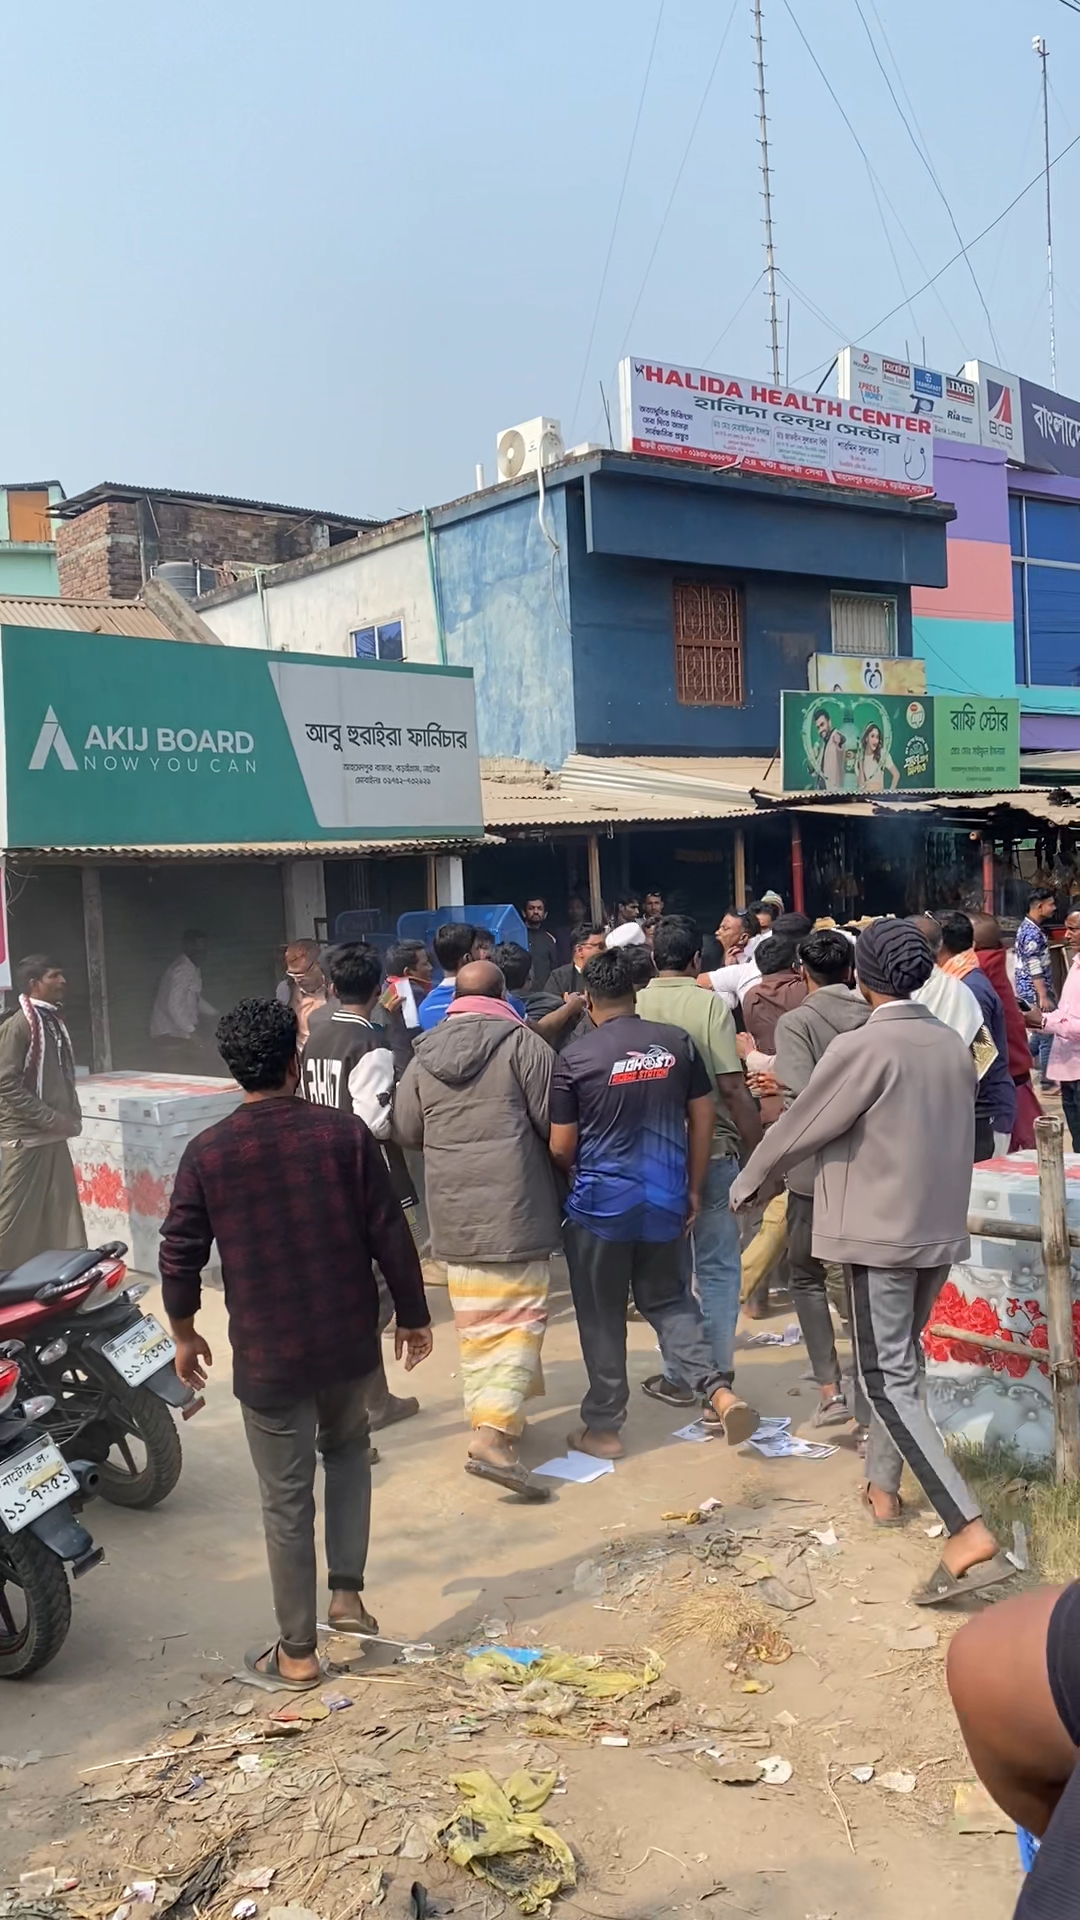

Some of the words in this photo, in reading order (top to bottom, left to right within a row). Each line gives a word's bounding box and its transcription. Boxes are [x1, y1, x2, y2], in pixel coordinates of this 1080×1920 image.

[858, 382, 880, 393] XPRESS
[950, 380, 974, 396] IME
[645, 365, 743, 398] HALIDA
[751, 386, 842, 418] HEALTH
[849, 405, 932, 435] CENTER
[693, 396, 768, 419] হালিদা
[836, 422, 901, 444] সেন্টার
[947, 410, 961, 422] Ria
[947, 427, 966, 438] Limited
[989, 420, 1013, 440] BCB
[950, 702, 977, 732] রাফি
[979, 706, 1009, 732] স্টোর
[84, 724, 148, 751] AKIJ
[157, 728, 254, 754] BOARD
[305, 723, 343, 752] আবু
[346, 721, 402, 748] হুরাইরা
[406, 722, 468, 748] ফার্নিচার
[84, 756, 139, 771] NOW
[150, 757, 198, 772] YOU
[210, 758, 256, 773] CAN
